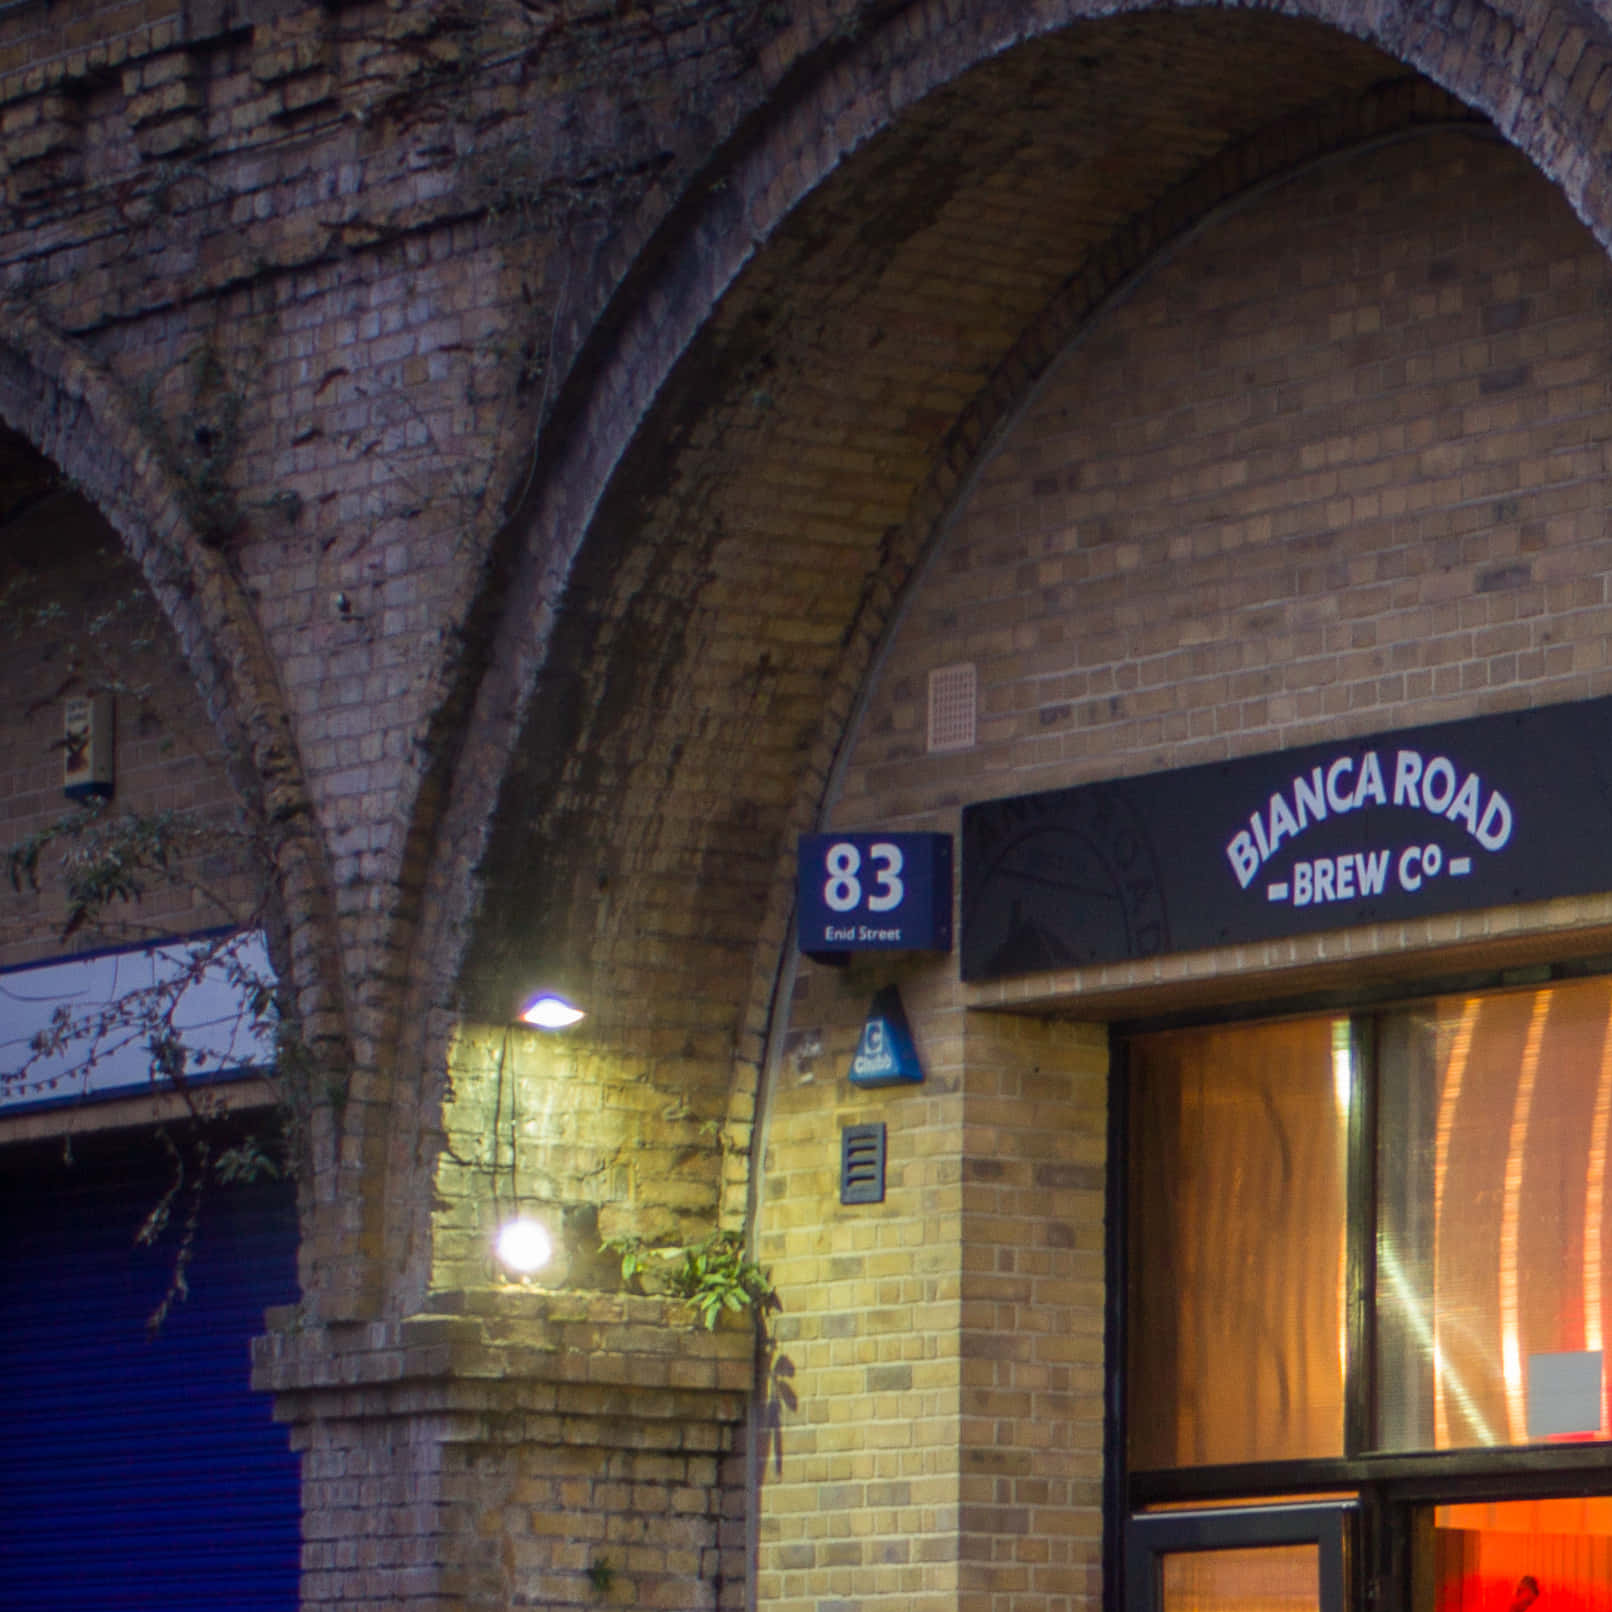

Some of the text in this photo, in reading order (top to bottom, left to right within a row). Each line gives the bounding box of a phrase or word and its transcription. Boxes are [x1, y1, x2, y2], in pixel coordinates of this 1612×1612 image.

[1226, 750, 1512, 890] BIANCA ROAD
[824, 842, 905, 912] 83
[1294, 849, 1391, 907] BREW
[824, 926, 902, 942] Enid Street
